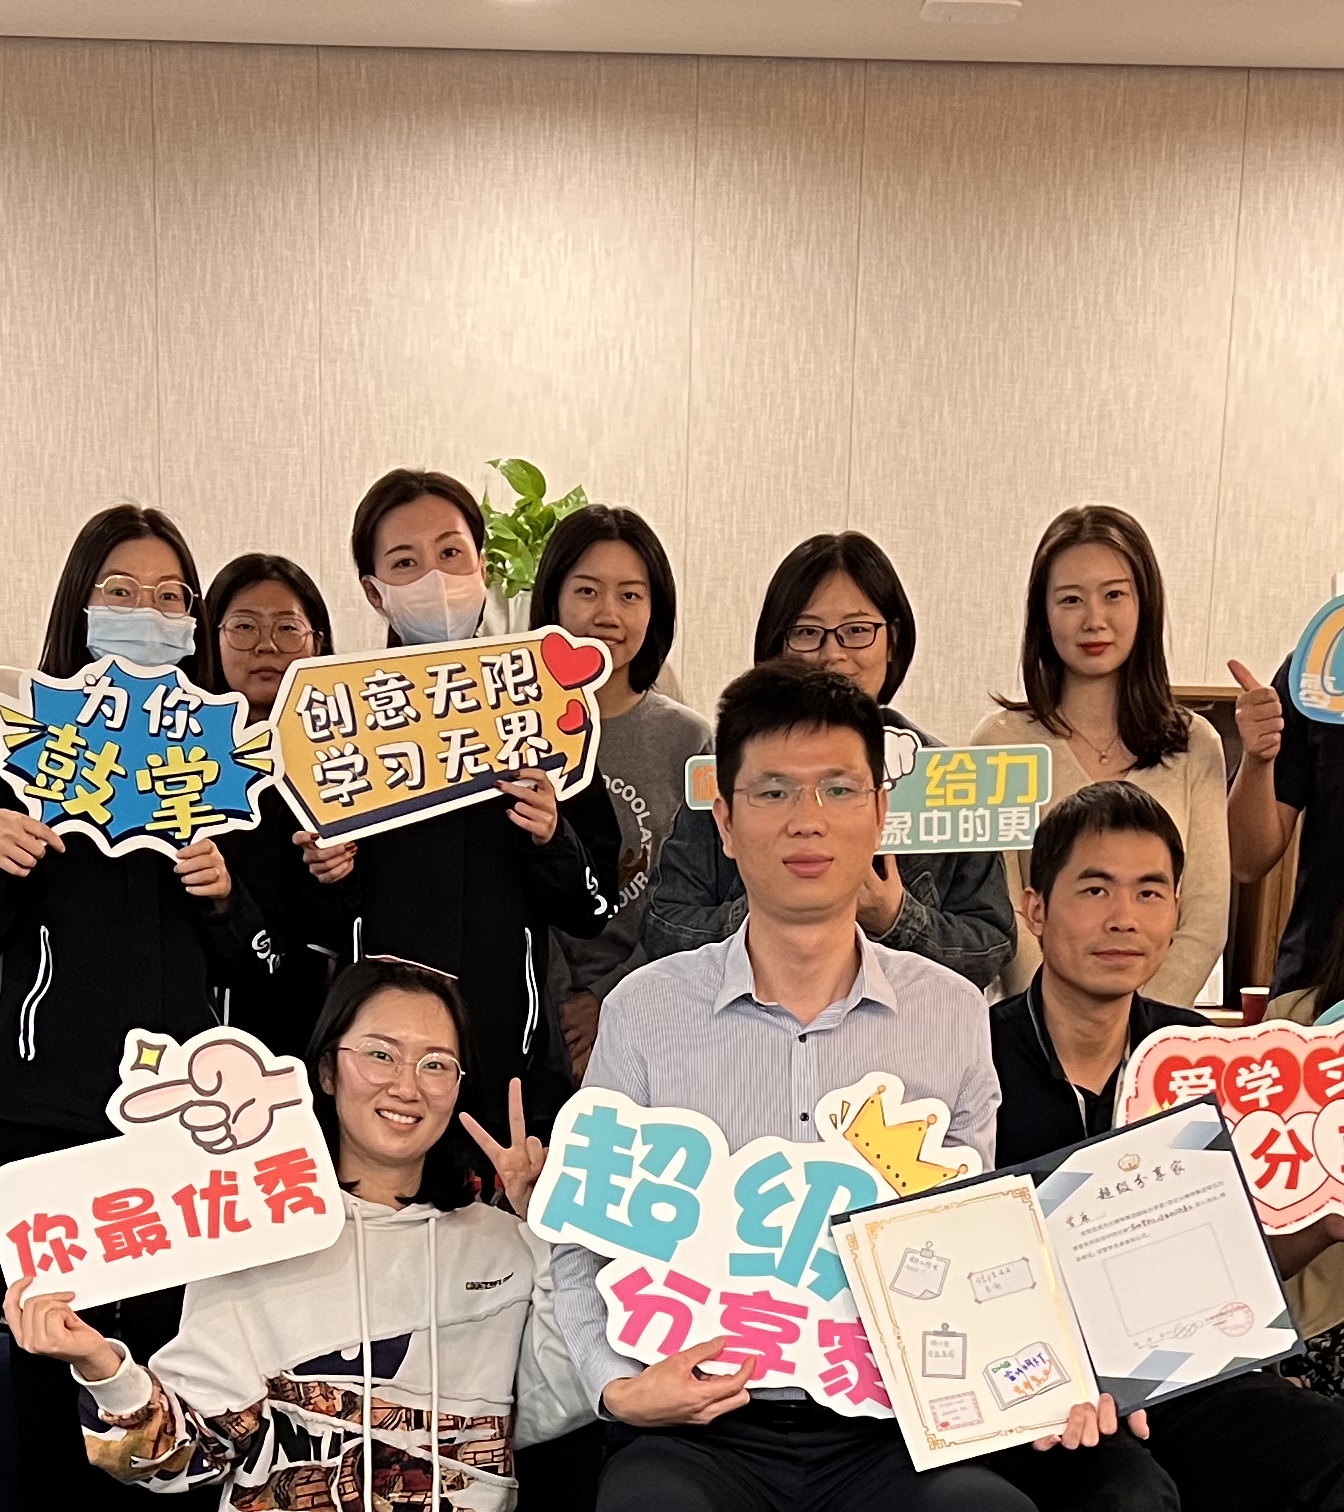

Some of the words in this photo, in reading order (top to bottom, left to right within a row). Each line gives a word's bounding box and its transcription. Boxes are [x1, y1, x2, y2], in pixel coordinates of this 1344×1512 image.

[80, 672, 202, 740] 为你
[295, 647, 538, 743] 创意无限
[24, 721, 227, 840] 鼓掌
[313, 714, 552, 808] 学习无界
[924, 750, 1039, 808] 给力
[5, 1147, 327, 1278] 你最优秀
[540, 1104, 880, 1301] 超级
